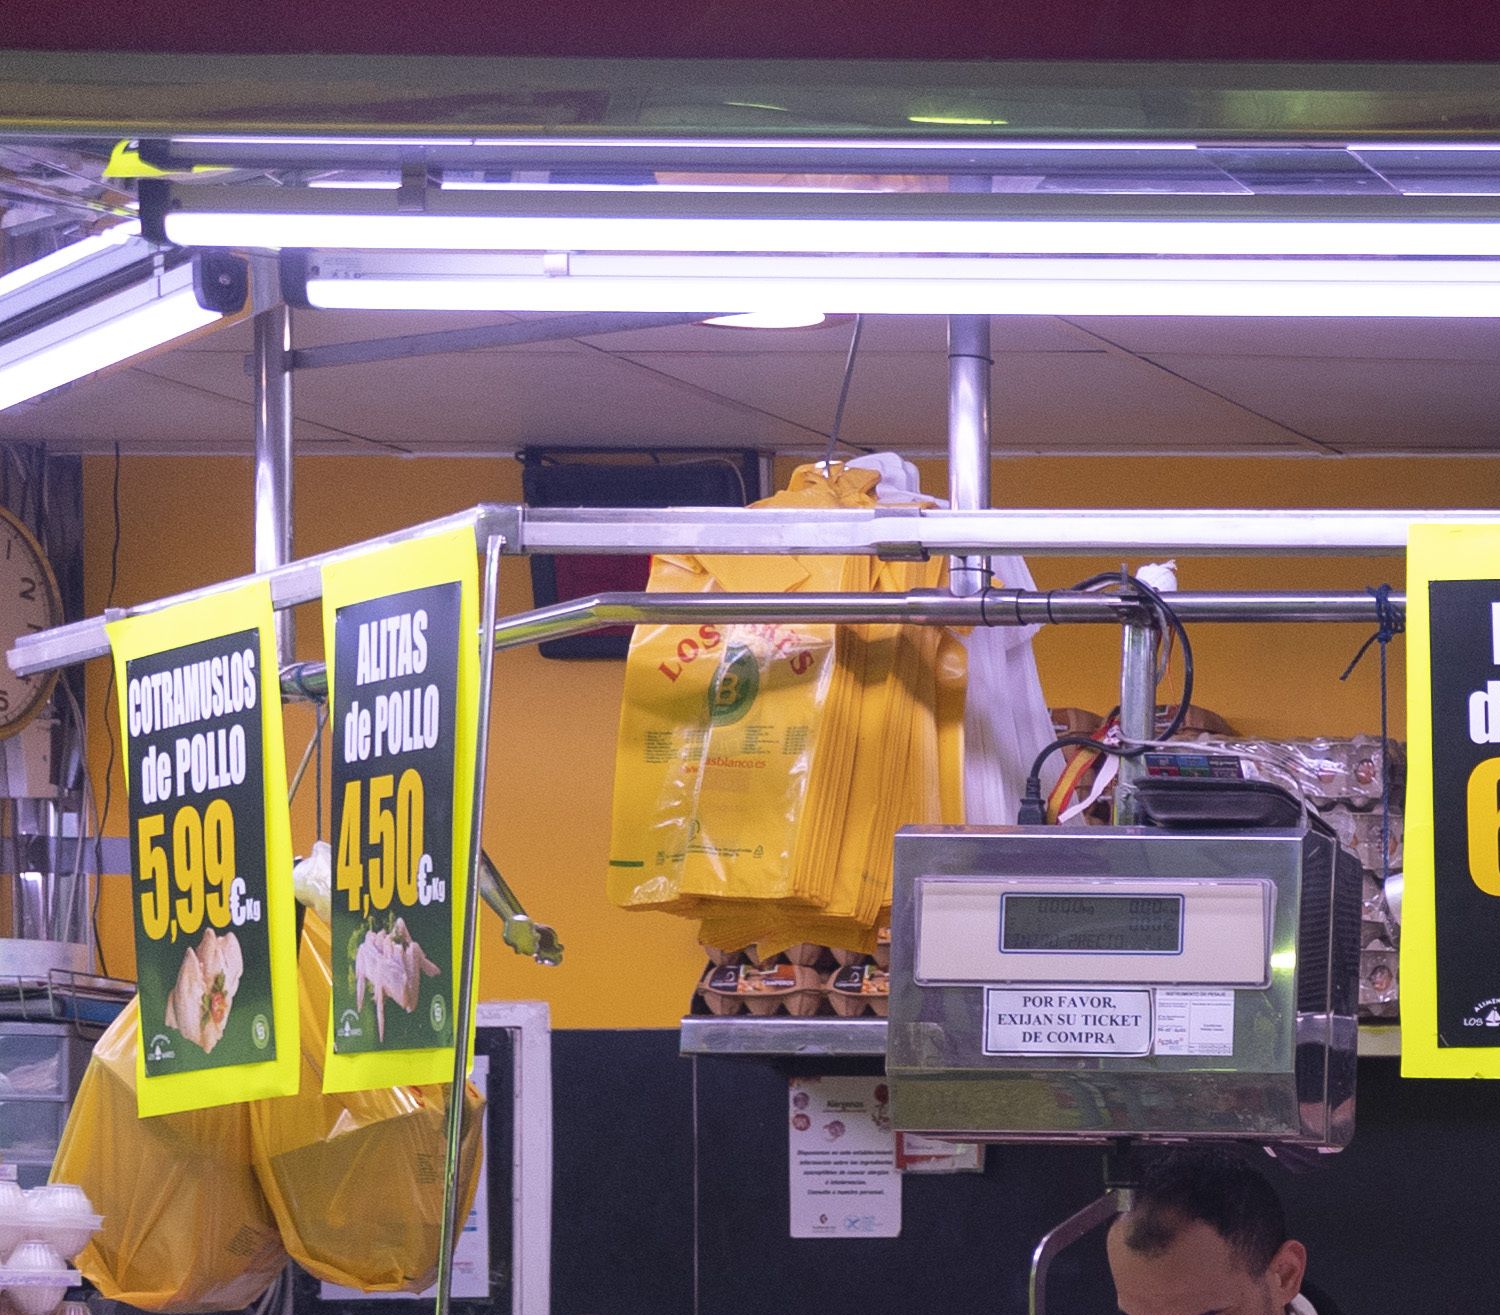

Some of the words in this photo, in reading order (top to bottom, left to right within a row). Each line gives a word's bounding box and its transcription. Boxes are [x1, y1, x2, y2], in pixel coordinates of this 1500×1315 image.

[357, 609, 427, 685] ALITAS
[129, 648, 256, 737] COTRAMUSLOS
[345, 701, 370, 763] de
[375, 684, 439, 757] POLLO
[141, 746, 173, 804] de
[175, 724, 246, 796] POLLO
